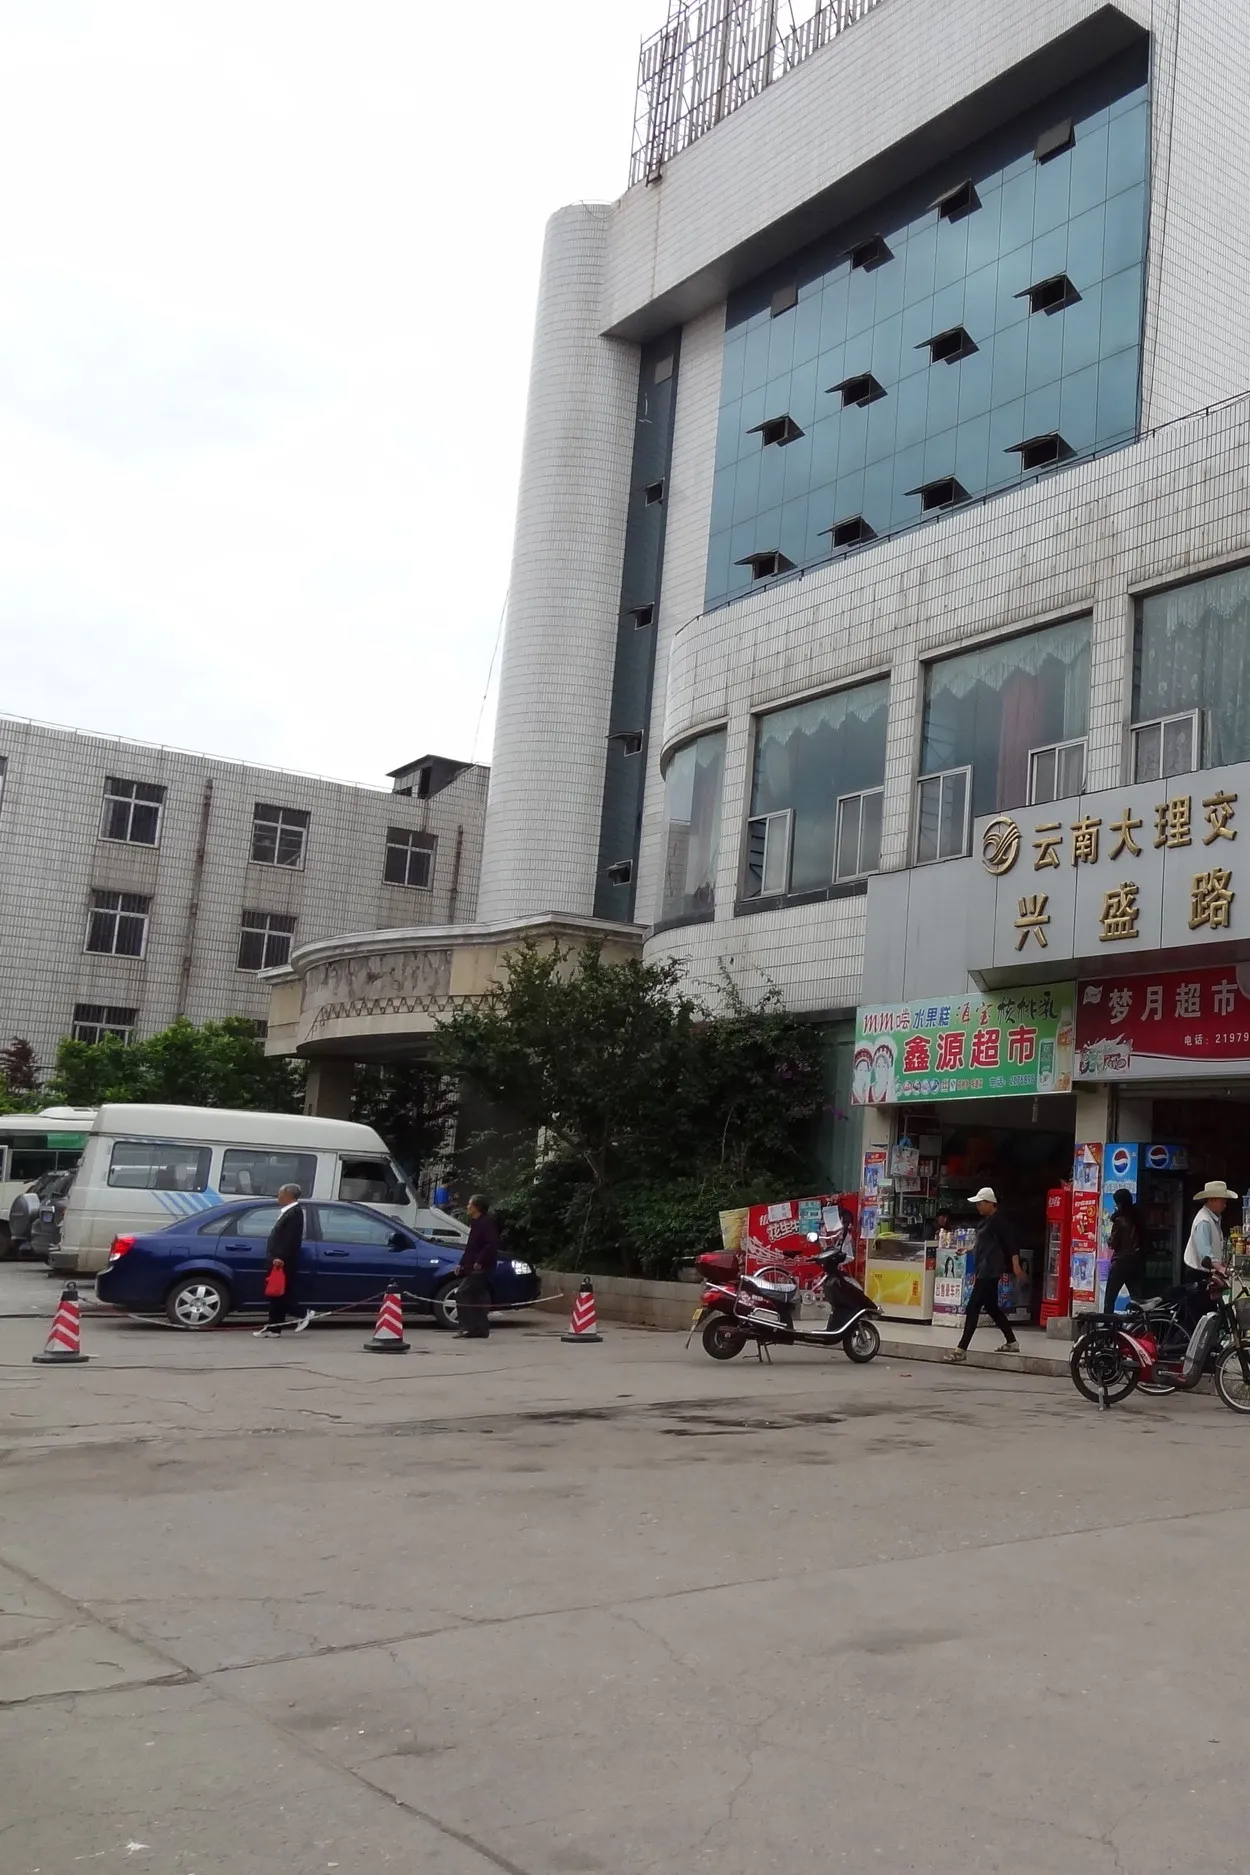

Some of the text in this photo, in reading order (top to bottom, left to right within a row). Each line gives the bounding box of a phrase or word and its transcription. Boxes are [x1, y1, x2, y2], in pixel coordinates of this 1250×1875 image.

[1108, 979, 1238, 1025] 梦月超市
[903, 1025, 1037, 1073] 鑫源超市
